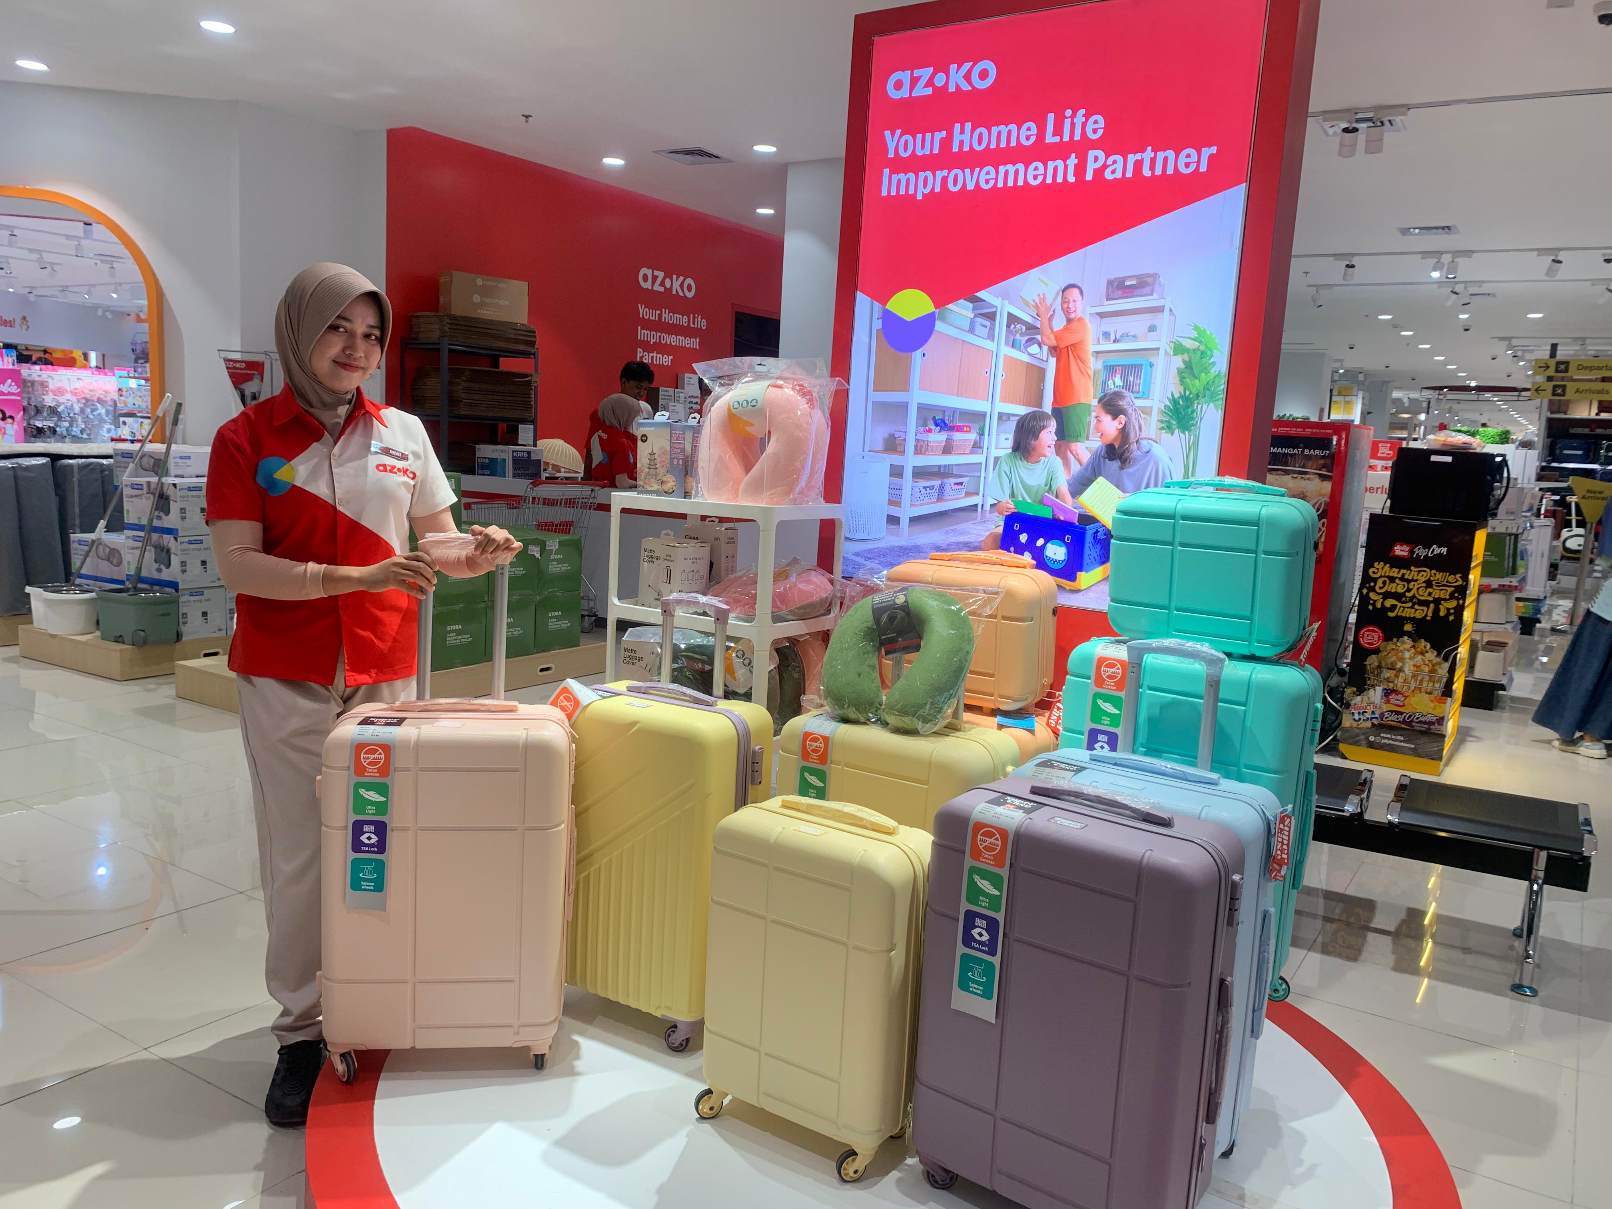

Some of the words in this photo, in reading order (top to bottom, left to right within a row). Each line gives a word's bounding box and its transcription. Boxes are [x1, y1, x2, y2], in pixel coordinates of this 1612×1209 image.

[884, 128, 946, 158] Your
[952, 120, 1038, 152] Home
[1045, 108, 1105, 144] Life
[881, 152, 1078, 200] Improvement
[1085, 146, 1217, 181] Partner
[638, 304, 660, 321] Your
[662, 308, 688, 327] Home
[690, 313, 707, 330] Life
[637, 326, 700, 350] Improvement
[637, 347, 673, 366] Partner
[1413, 545, 1428, 559] Pop
[1428, 544, 1448, 557] Corn
[1369, 562, 1430, 581] Sharing
[1375, 577, 1408, 593] One
[1405, 580, 1455, 600] Kernel
[1384, 599, 1435, 620] Time!
[1352, 710, 1380, 722] USA
